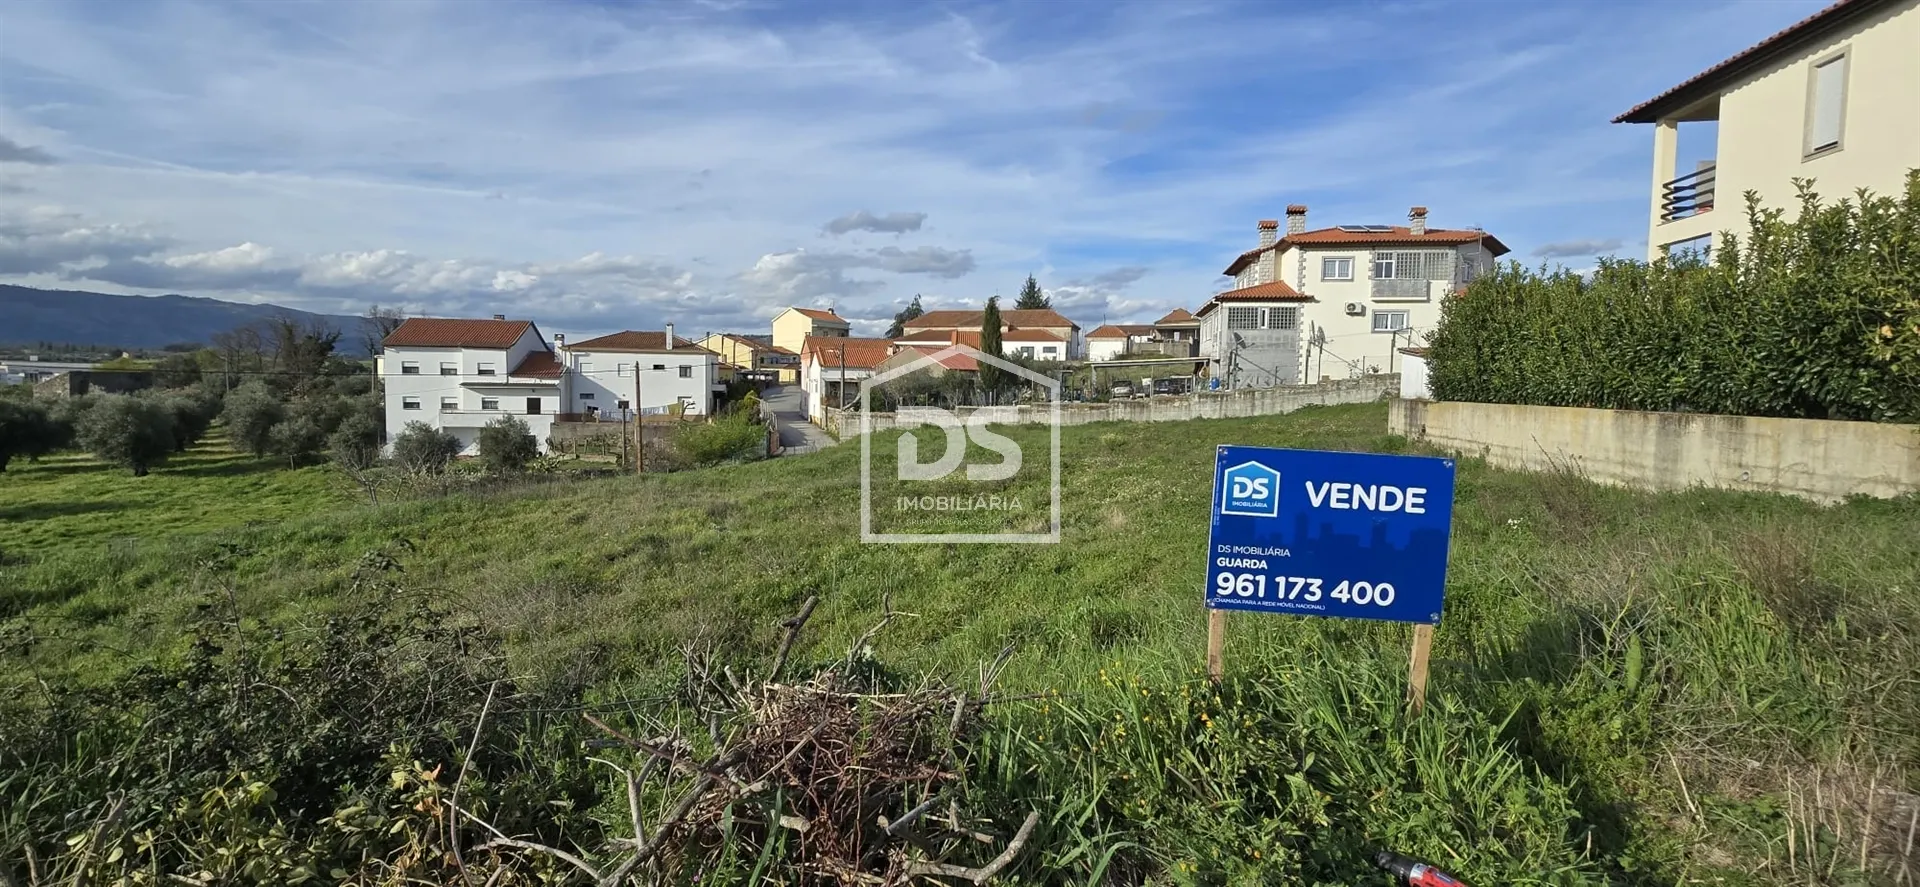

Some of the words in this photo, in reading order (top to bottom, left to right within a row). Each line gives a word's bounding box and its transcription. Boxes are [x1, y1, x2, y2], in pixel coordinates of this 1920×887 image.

[1233, 476, 1269, 499] DS
[1305, 481, 1427, 514] VENDE
[1218, 545, 1231, 553] DS
[1233, 546, 1290, 557] IMOBILIÁRIA
[1217, 557, 1268, 569] GUARDA
[1216, 572, 1266, 598] 961
[1275, 576, 1323, 602] 173
[1330, 580, 1395, 606] 400
